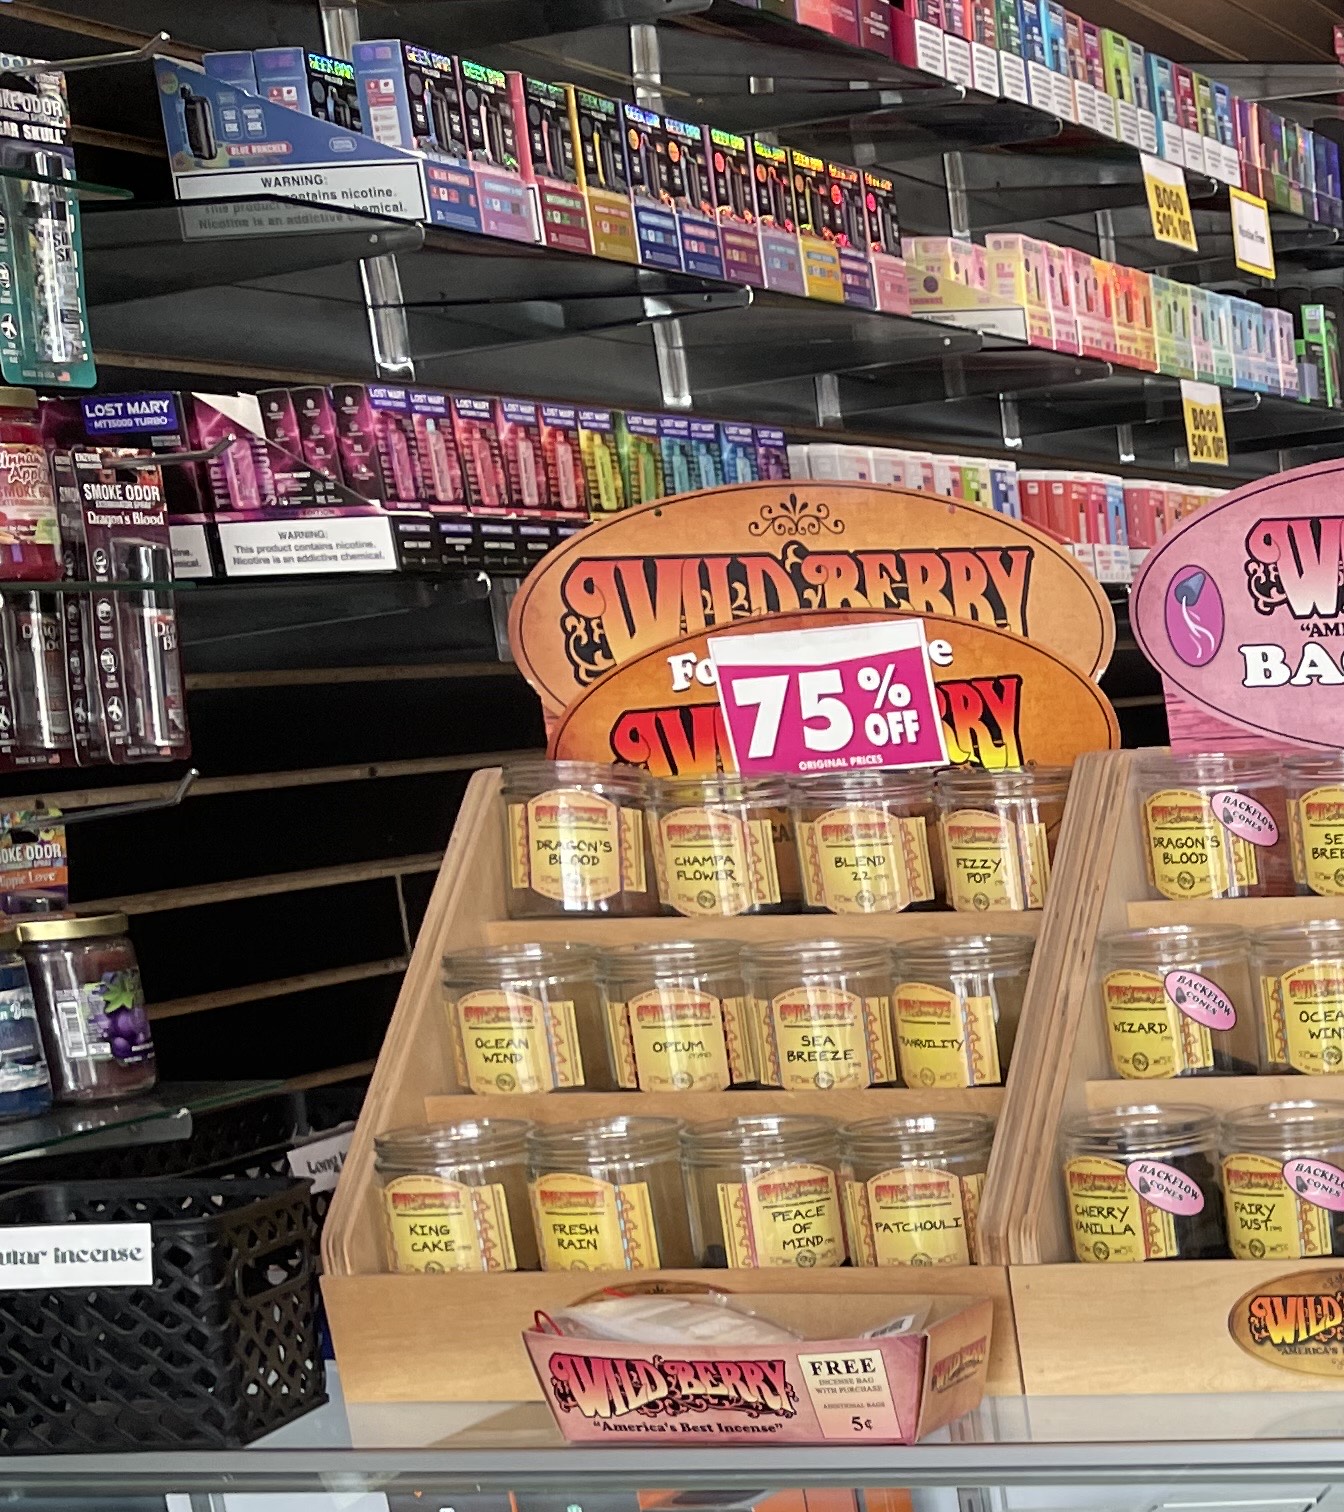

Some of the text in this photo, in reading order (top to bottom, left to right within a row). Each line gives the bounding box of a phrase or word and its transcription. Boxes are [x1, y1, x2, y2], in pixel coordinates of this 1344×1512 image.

[261, 174, 328, 188] WARNING:
[1154, 184, 1184, 216] BOGO
[1155, 210, 1193, 245] 50% OFF
[84, 399, 171, 418] LOST MARY
[134, 415, 168, 427] TURBO
[83, 481, 162, 501] SMOKE ODOR
[87, 509, 165, 526] Dragon's Blood
[797, 545, 1034, 632] BERRY
[864, 709, 921, 748] OFF
[799, 754, 884, 771] ORIGINAL PRICES
[1152, 833, 1221, 851] DRAGON'S
[834, 854, 887, 869] BLEND
[955, 856, 1003, 872] FIZZY
[1162, 850, 1209, 866] BLOOD
[965, 870, 991, 885] POP
[1114, 1020, 1169, 1036] WIZARD
[652, 1040, 705, 1055] OPIUM
[1074, 1203, 1130, 1223] CHERRY
[1233, 1201, 1276, 1220] FAIRY
[873, 1217, 964, 1234] PATCHOULI
[1239, 1216, 1272, 1233] DUST
[1249, 1294, 1342, 1345] WILD
[810, 1357, 876, 1377] FREE
[549, 1351, 797, 1420] WILD BERRY
[851, 1415, 874, 1432] 5¢
